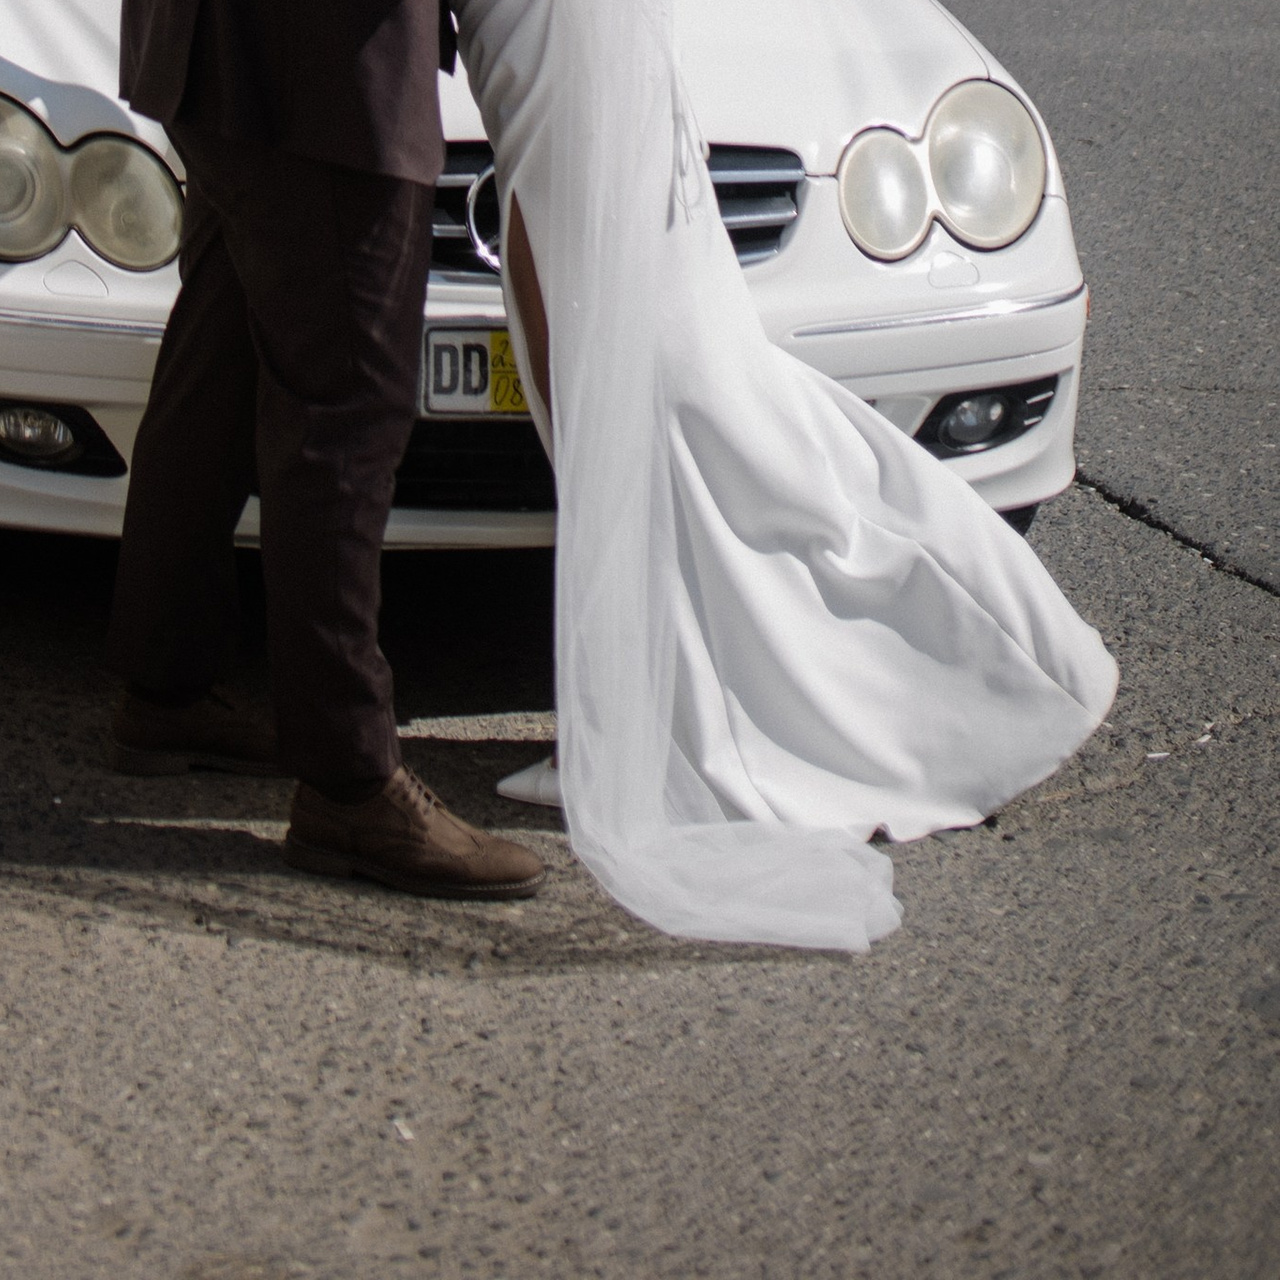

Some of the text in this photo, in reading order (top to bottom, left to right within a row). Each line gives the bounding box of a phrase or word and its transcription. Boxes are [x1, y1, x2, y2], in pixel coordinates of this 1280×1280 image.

[492, 340, 517, 368] 2
[433, 344, 489, 396] DD
[494, 375, 524, 406] 08
